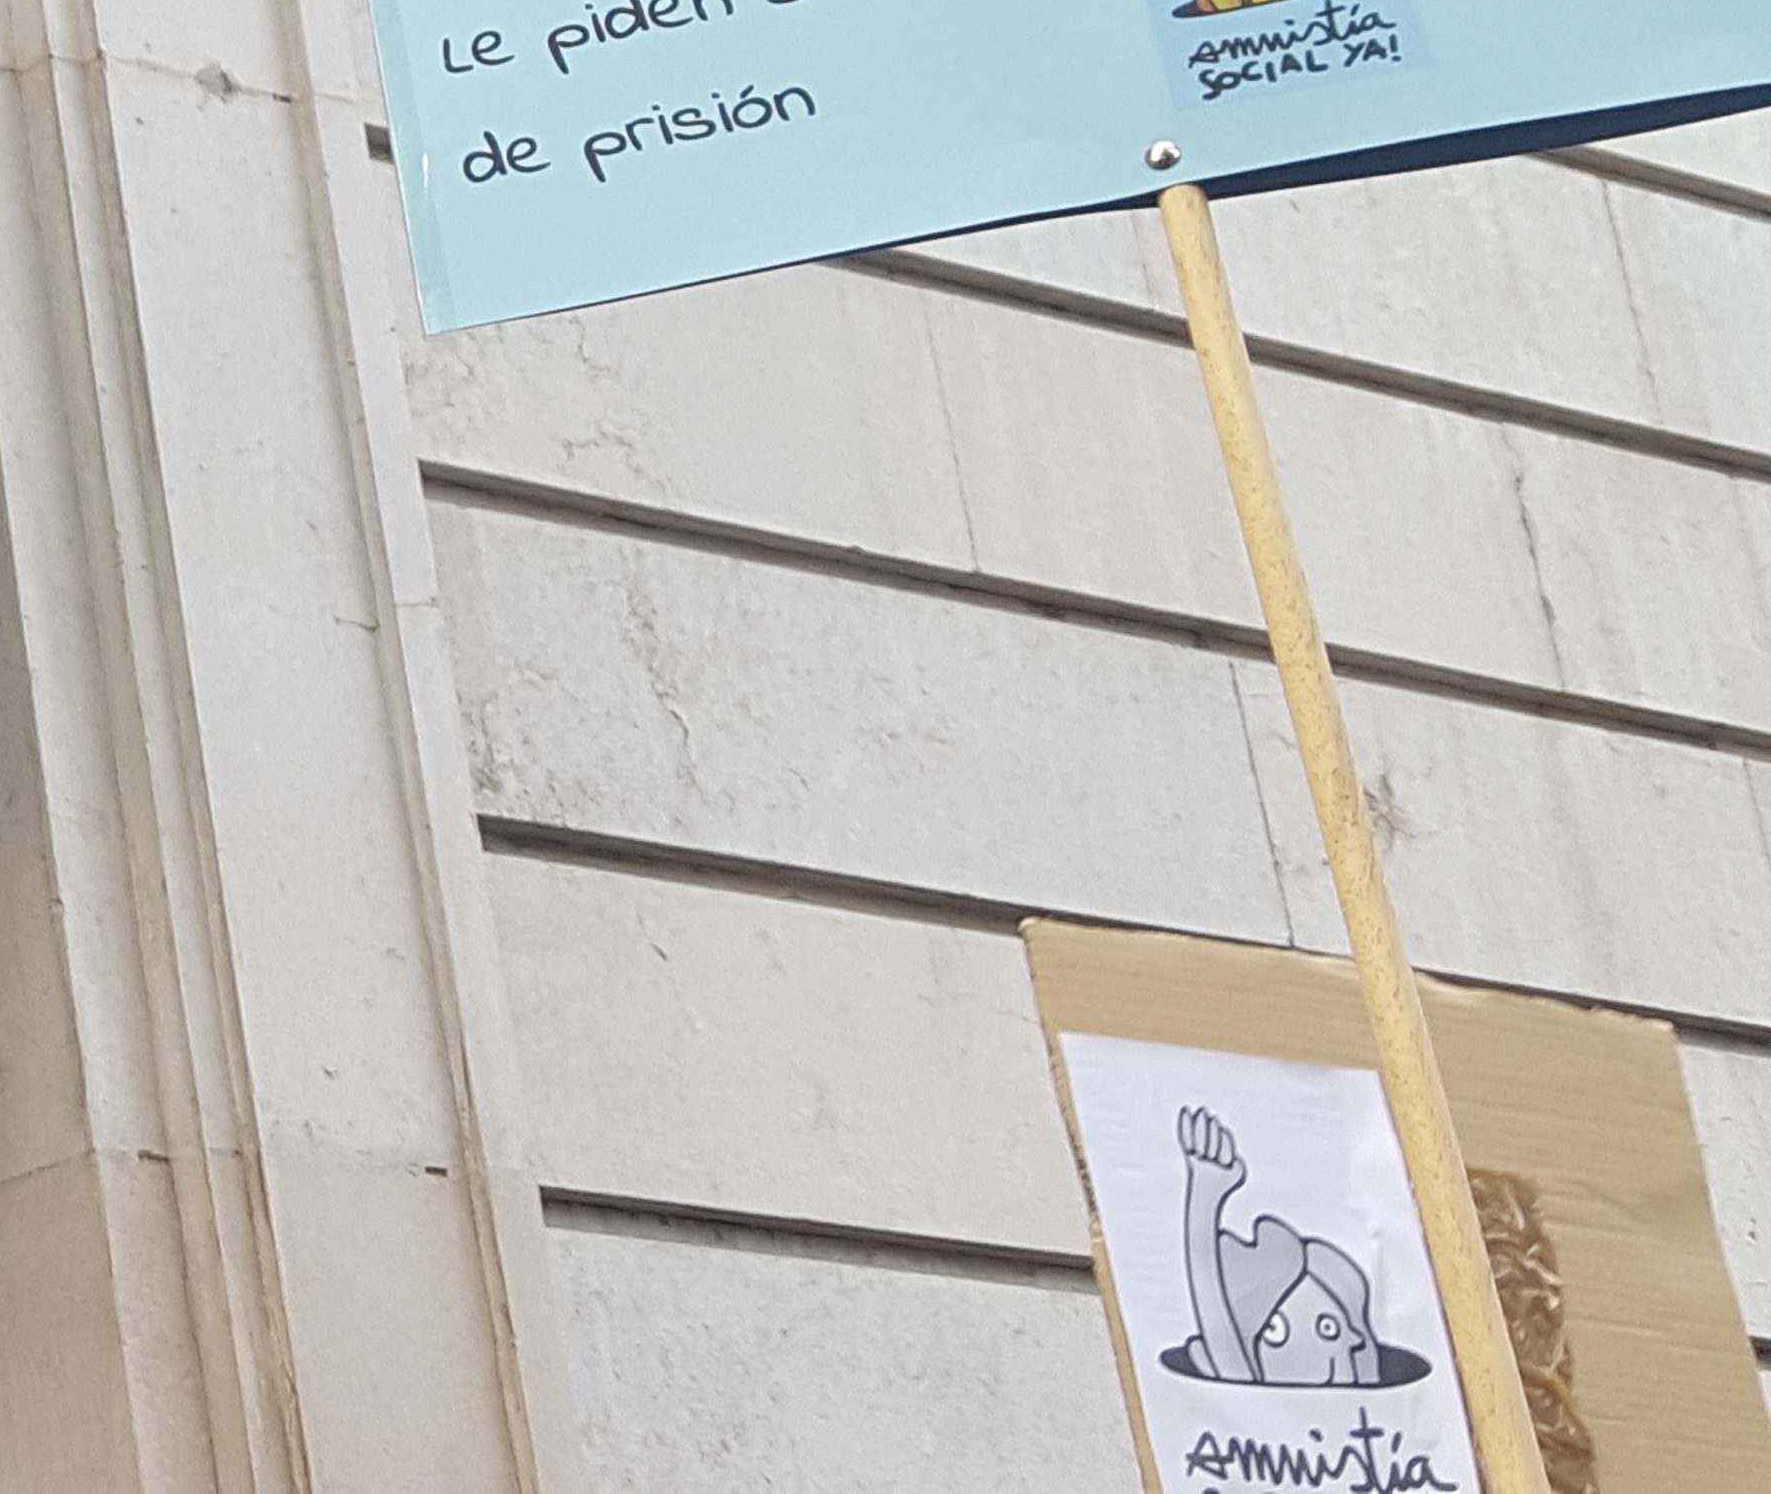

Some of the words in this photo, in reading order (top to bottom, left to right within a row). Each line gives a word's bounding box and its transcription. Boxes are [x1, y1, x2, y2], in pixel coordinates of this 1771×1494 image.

[1197, 49, 1330, 101] SOCIAL
[1342, 34, 1402, 68] YA!
[461, 130, 553, 184] de
[583, 83, 819, 183] prisión
